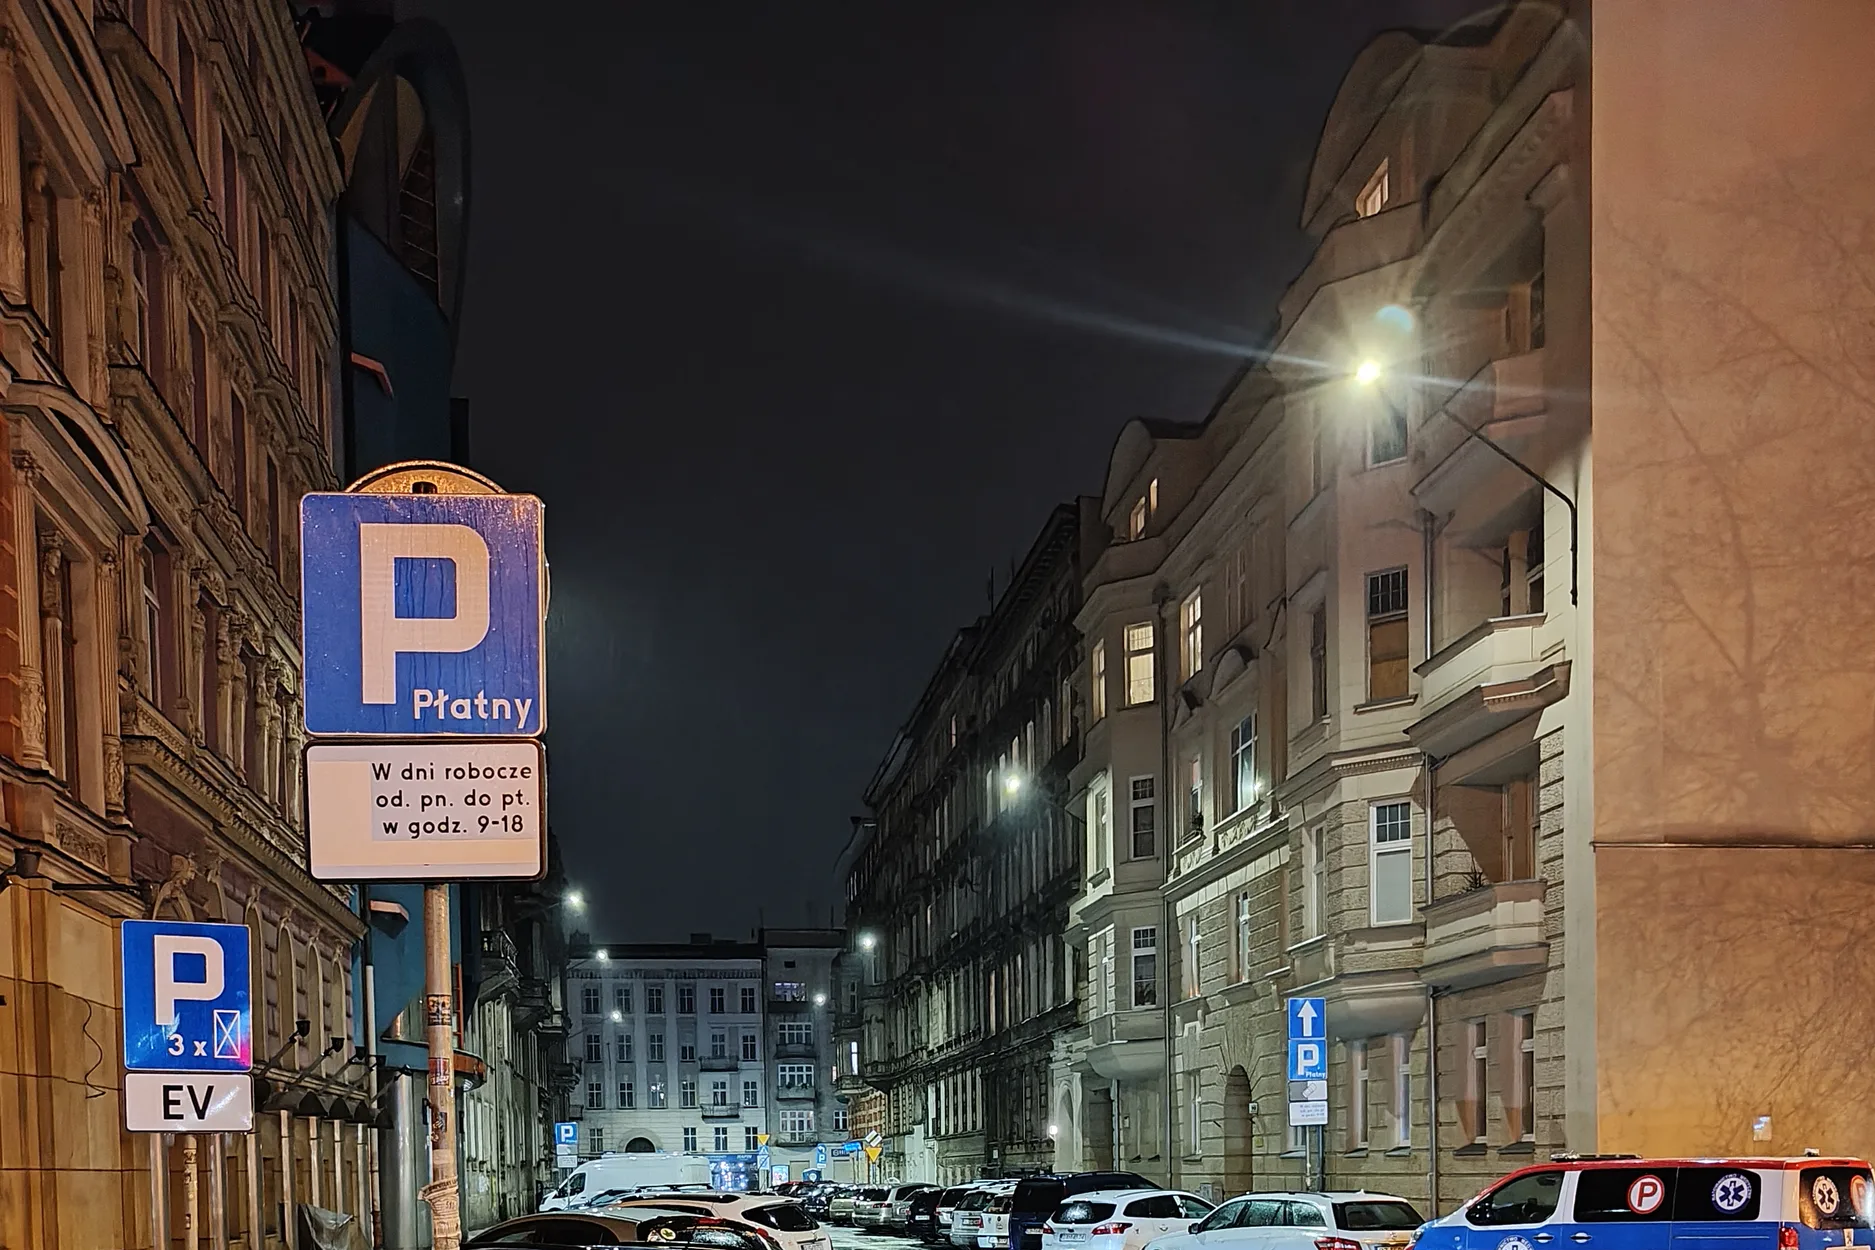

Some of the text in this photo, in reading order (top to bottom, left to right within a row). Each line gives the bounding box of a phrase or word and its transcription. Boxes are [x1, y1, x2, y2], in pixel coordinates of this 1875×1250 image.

[360, 523, 490, 704] P
[413, 688, 533, 729] Płatny
[372, 762, 532, 781] W dni robocze
[376, 788, 530, 812] od. pn. do pt.
[383, 814, 524, 839] w godz. 9-18
[154, 935, 225, 1025] P
[168, 1033, 207, 1057] 3 x
[1297, 1043, 1319, 1076] P
[162, 1085, 215, 1121] EV
[561, 1125, 574, 1142] P
[1637, 1181, 1658, 1207] P
